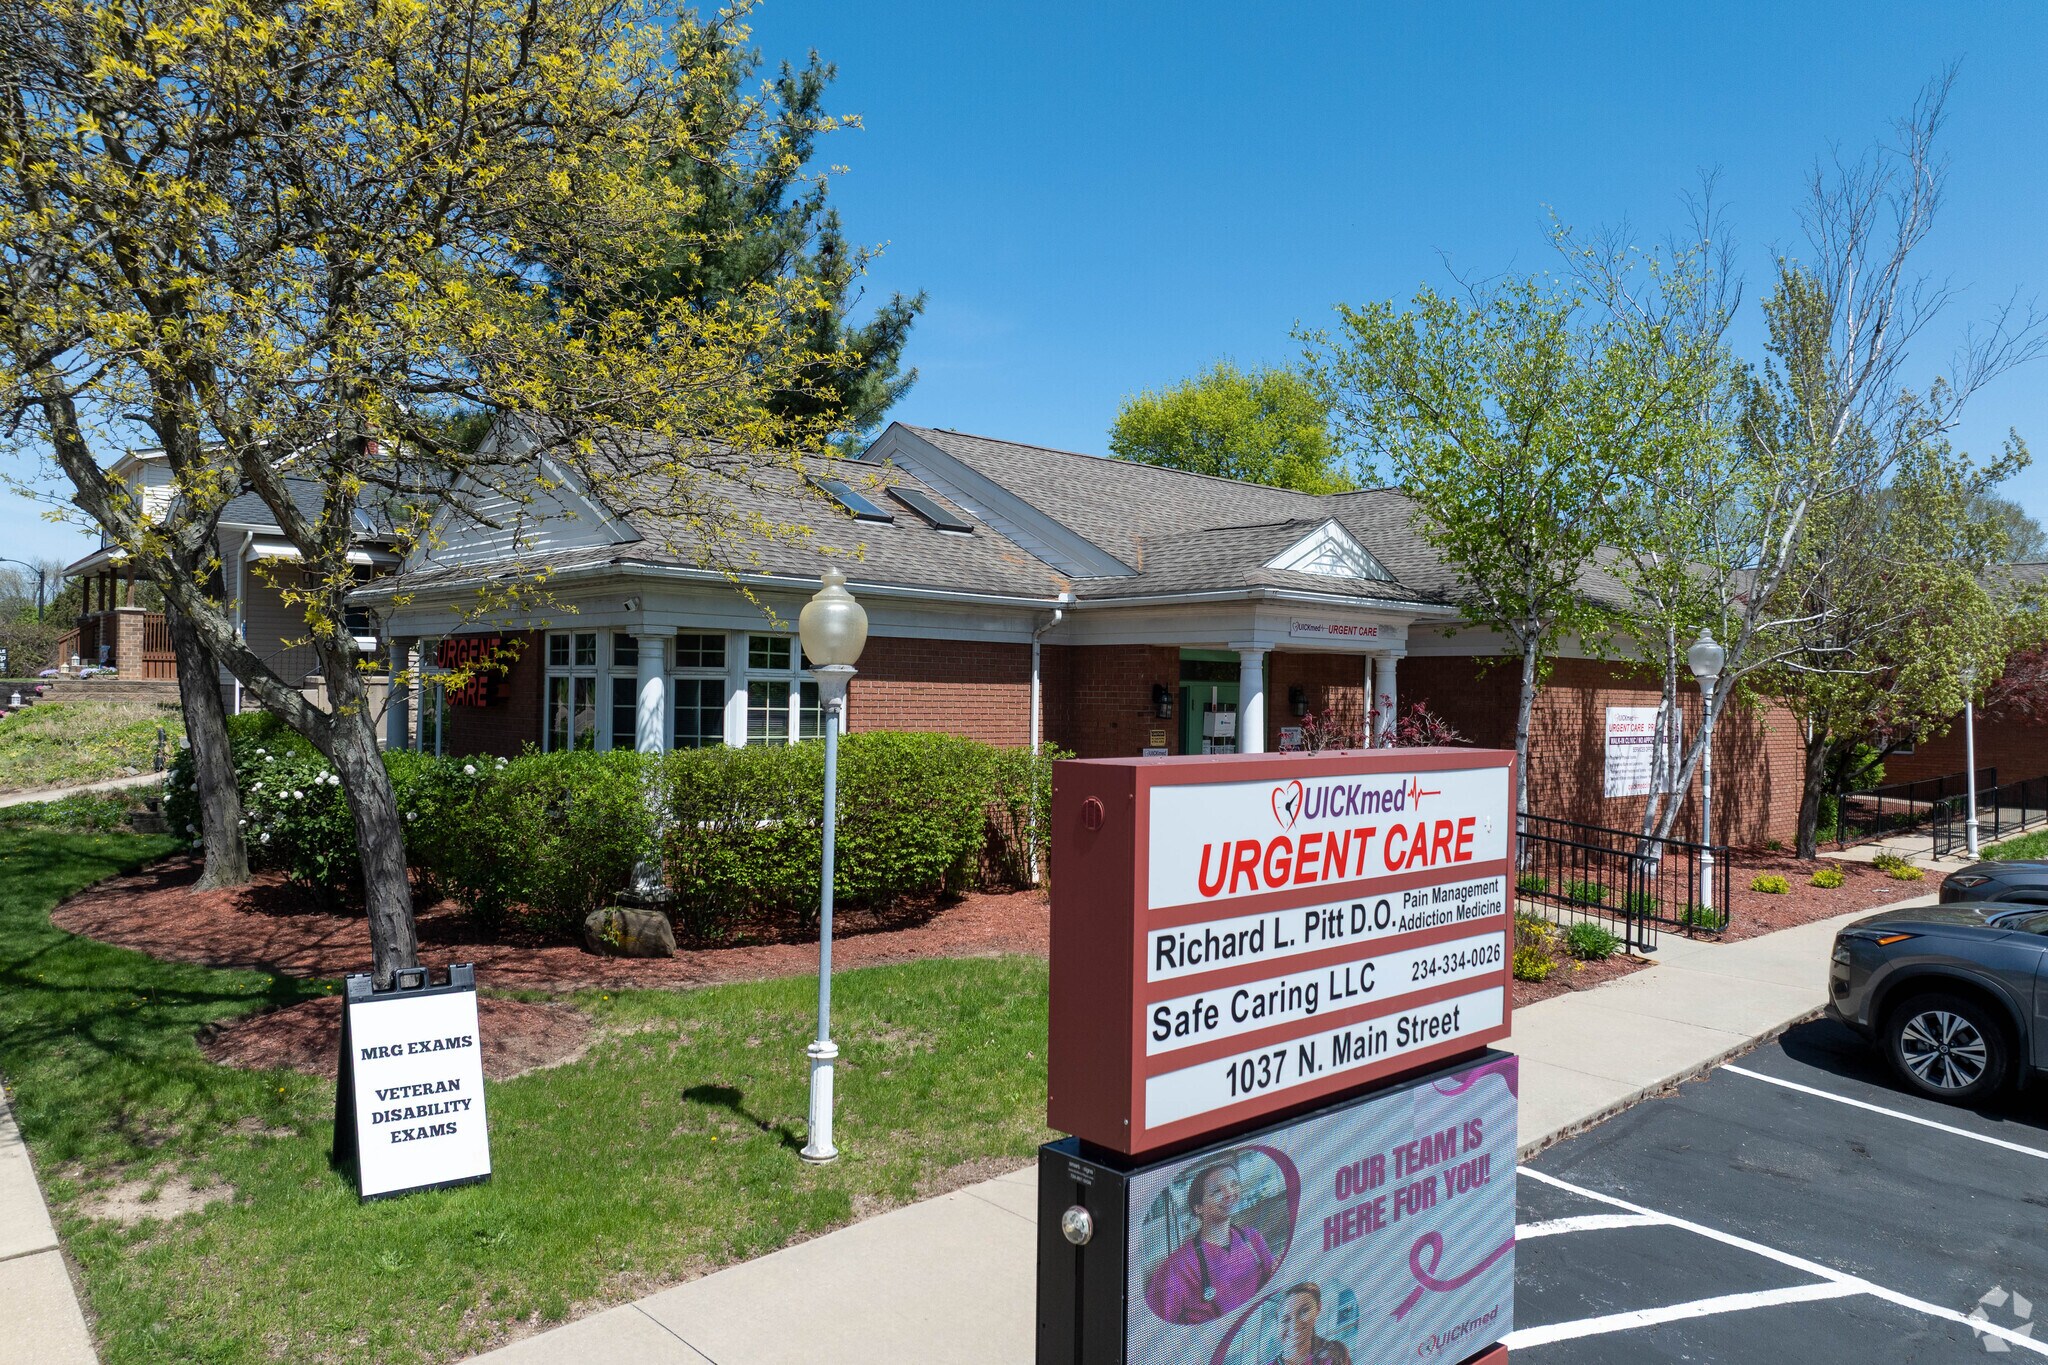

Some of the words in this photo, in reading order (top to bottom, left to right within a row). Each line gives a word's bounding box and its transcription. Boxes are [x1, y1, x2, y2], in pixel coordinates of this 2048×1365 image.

[1328, 624, 1358, 636] URGENT
[1359, 626, 1378, 637] CARE
[437, 638, 501, 668] URGENT
[1609, 723, 1630, 732] URGENT
[1631, 723, 1645, 732] CARE
[1198, 827, 1376, 898] URGENT
[1384, 816, 1476, 872] CARE
[1403, 888, 1429, 910] Pain
[1432, 879, 1499, 907] Management
[1398, 907, 1453, 933] Addiction
[1456, 899, 1502, 923] Medicine
[1156, 920, 1265, 971] Richard
[1274, 918, 1295, 949] L.
[1305, 907, 1344, 944] Pitt
[1351, 898, 1396, 935] D.O.
[1412, 945, 1501, 982] 234-334-0026
[1152, 1001, 1219, 1042] Safe
[1230, 977, 1319, 1019] Caring
[1330, 962, 1376, 1001] LLC
[361, 1044, 404, 1061] MRG
[407, 1035, 473, 1056] EXAMS
[1226, 1049, 1287, 1097] 1037
[1298, 1041, 1323, 1077] N.
[1332, 1027, 1387, 1068] Main
[1397, 1005, 1461, 1048] Street
[375, 1078, 461, 1102] VETERAN
[371, 1098, 473, 1125] DISABILITY
[390, 1121, 458, 1144] EXAMS
[1335, 1153, 1386, 1201] OUR
[1392, 1127, 1457, 1178] TEAM
[1463, 1117, 1483, 1153] IS
[1323, 1195, 1386, 1252] HERE
[1394, 1177, 1437, 1222] FOR
[1444, 1152, 1491, 1200] YOU!
